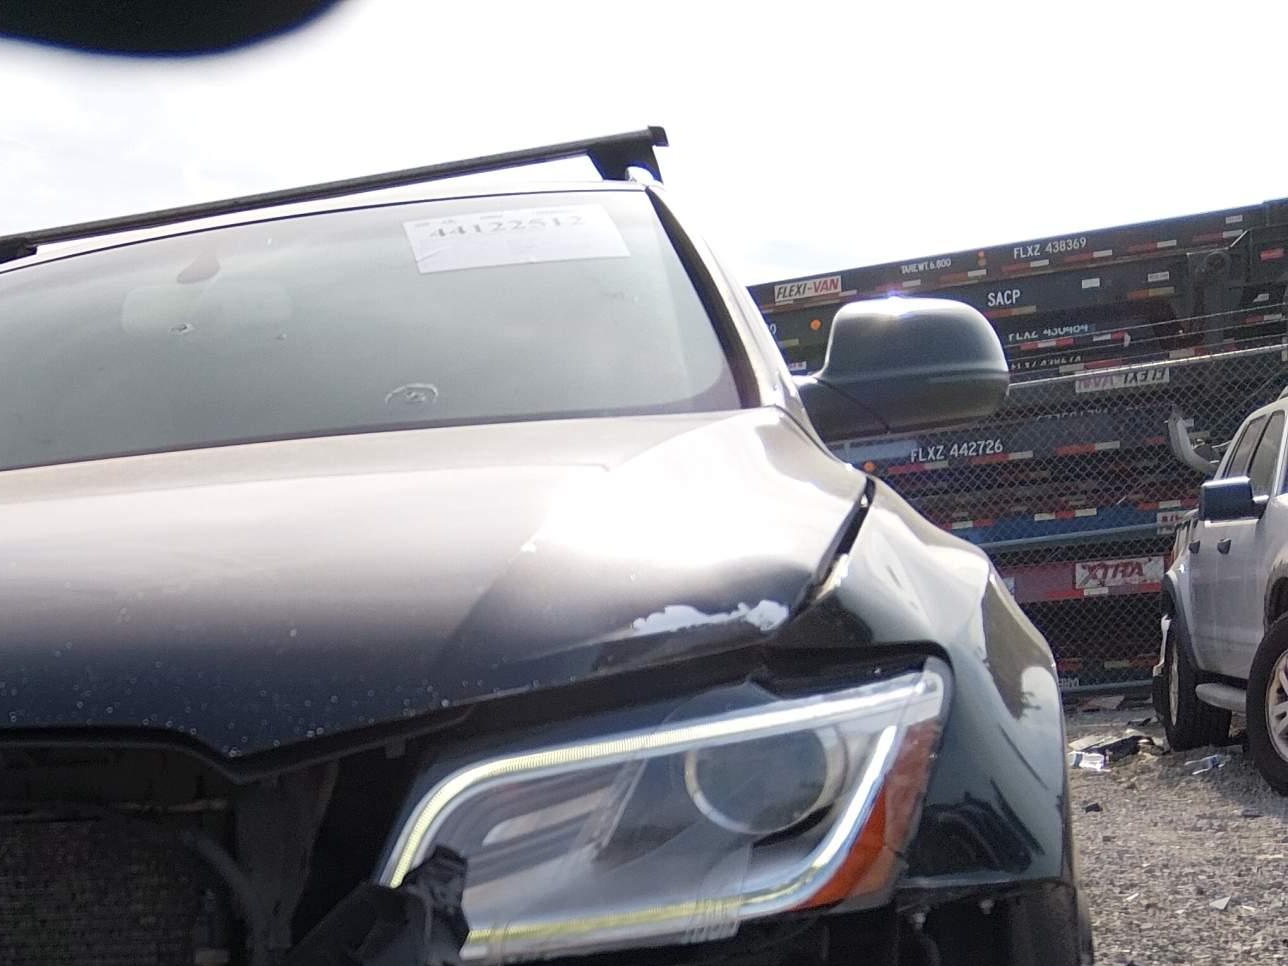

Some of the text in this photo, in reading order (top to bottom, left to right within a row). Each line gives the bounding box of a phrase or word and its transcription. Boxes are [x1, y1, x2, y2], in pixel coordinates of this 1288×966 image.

[428, 214, 586, 238] 44122512
[1013, 236, 1087, 259] FLXZ 438369
[776, 278, 839, 299] FLEXI-VAN
[987, 289, 1021, 306] SACP
[911, 438, 1003, 462] FLXZ 442726
